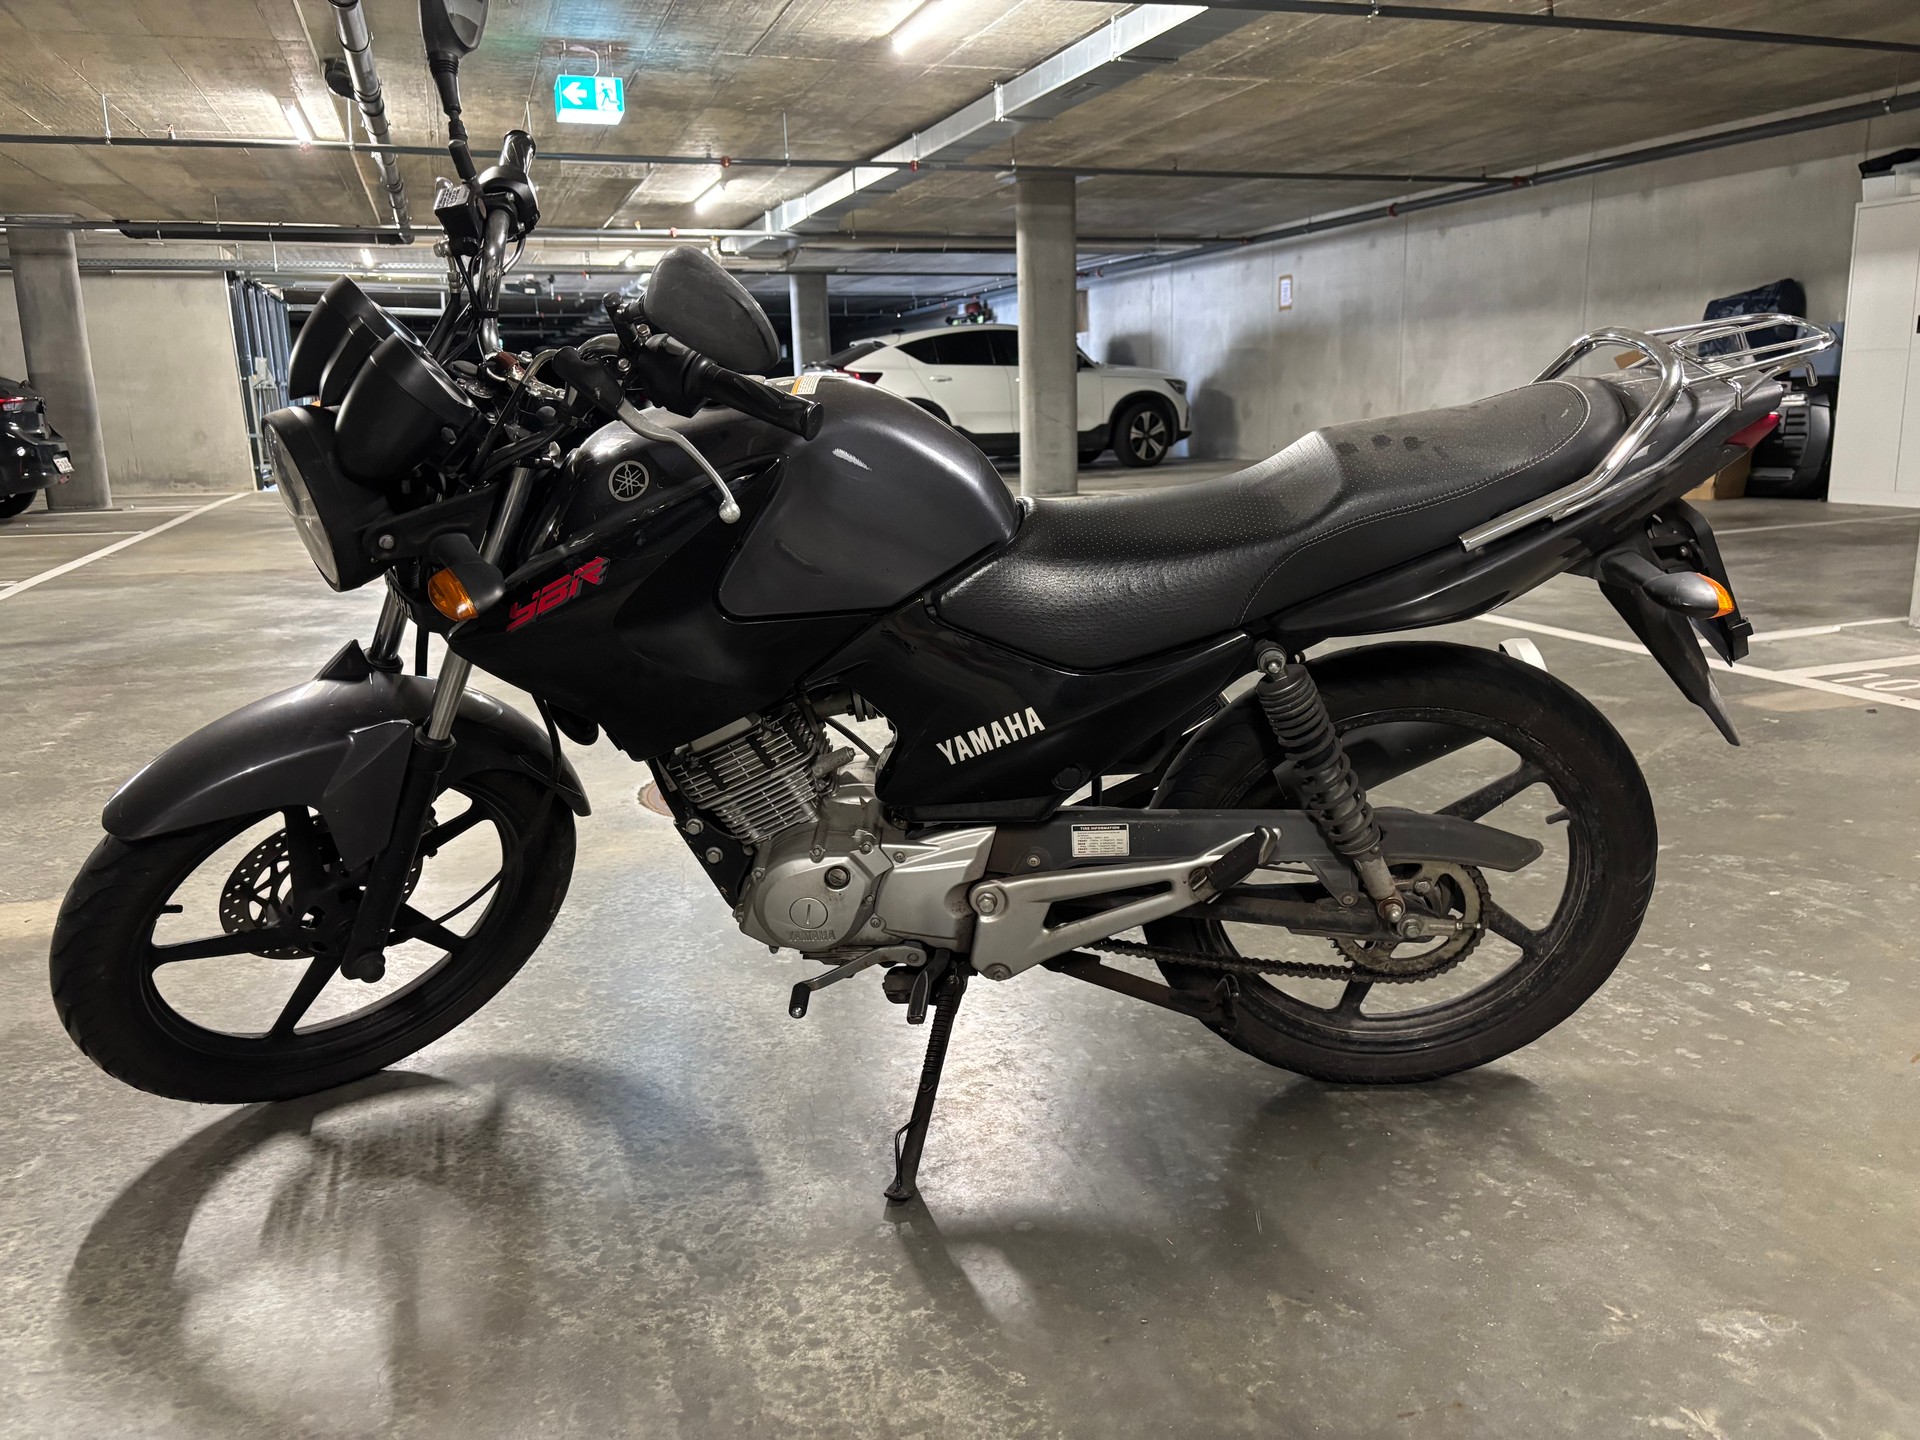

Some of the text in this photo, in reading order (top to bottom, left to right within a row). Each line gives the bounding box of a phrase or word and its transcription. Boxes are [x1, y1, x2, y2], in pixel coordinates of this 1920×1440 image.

[507, 556, 609, 632] YBR
[936, 706, 1046, 765] YAMAHA
[786, 930, 836, 942] YAMAHA
